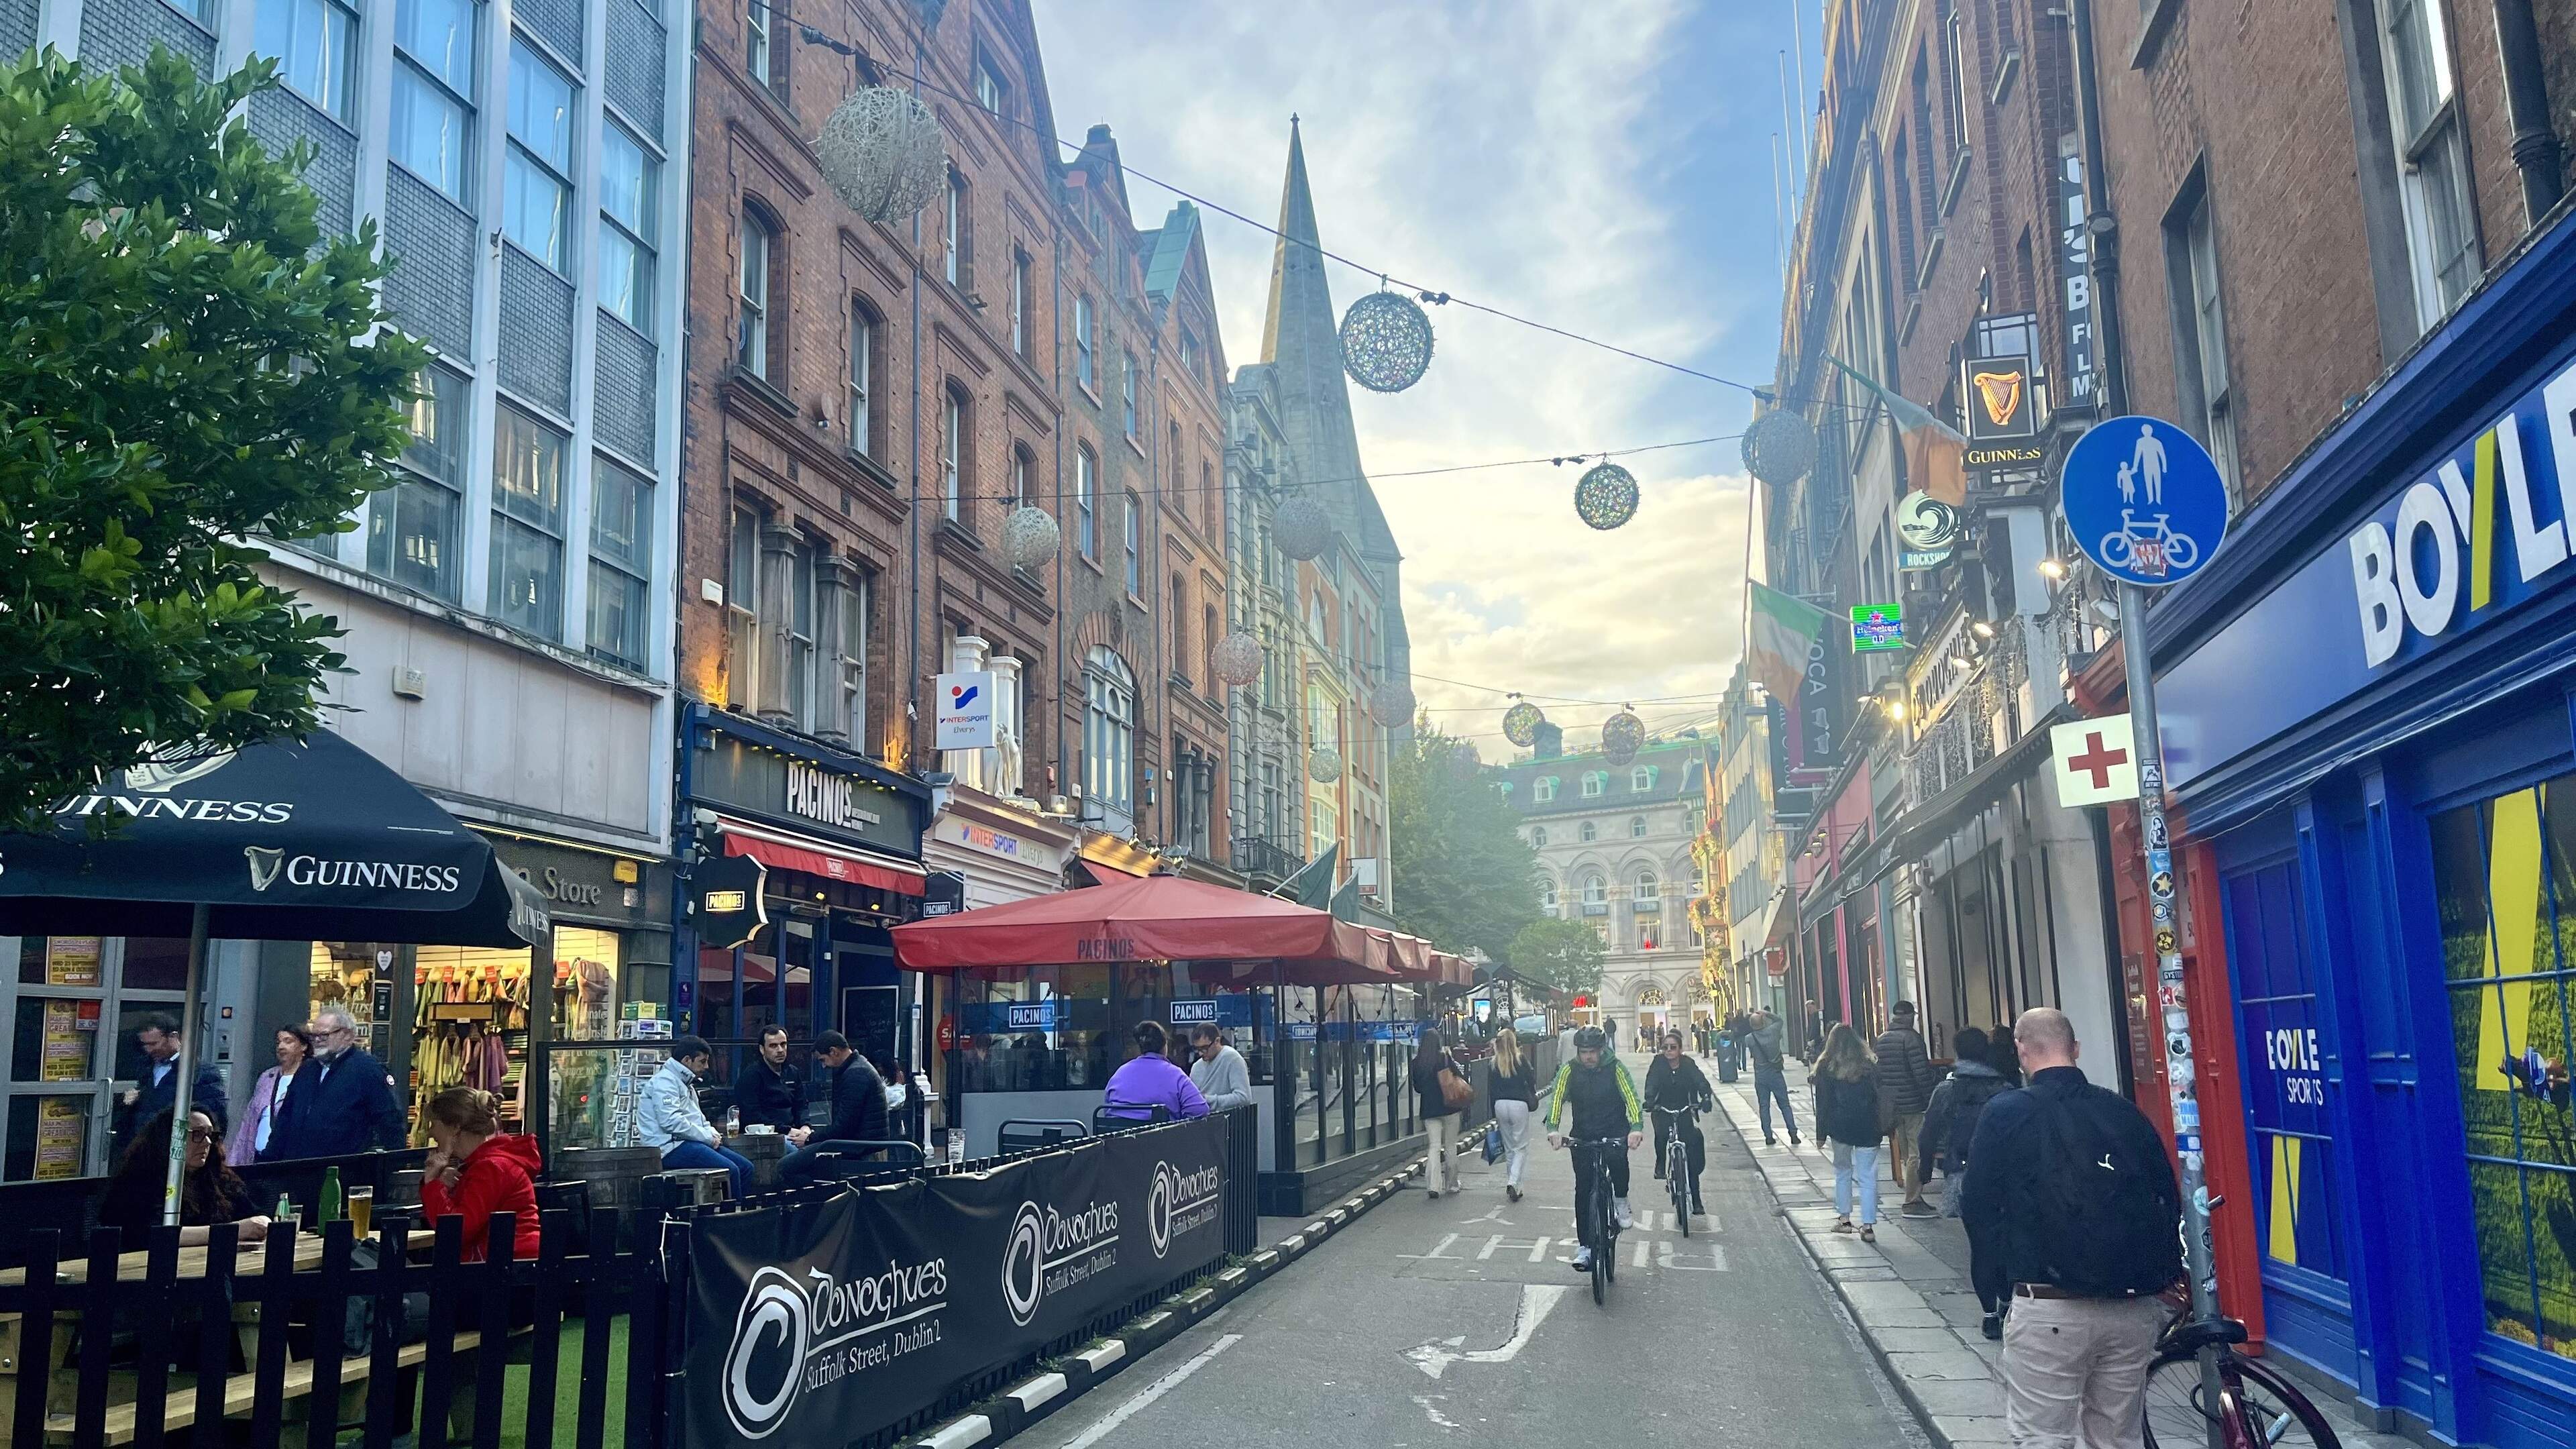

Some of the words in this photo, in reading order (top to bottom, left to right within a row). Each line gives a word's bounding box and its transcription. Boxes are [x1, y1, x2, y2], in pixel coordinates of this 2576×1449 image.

[1808, 637, 1827, 696] OCA
[947, 715, 989, 723] INTERSPORT
[787, 761, 853, 826] PACINOS
[46, 795, 294, 824] UINNESS
[970, 826, 1018, 855] INTERSPORT
[287, 855, 460, 892] GUINNESS
[544, 867, 602, 905] Store
[709, 894, 742, 908] PACINOS
[925, 905, 949, 915] PACINOS
[1078, 939, 1134, 959] PACINOS
[1013, 1009, 1051, 1024] PACINOS
[1175, 1004, 1214, 1020] PACINOS
[2287, 1077, 2323, 1106] SPORTS
[1046, 1267, 1069, 1296] Suffolk
[1091, 1250, 1112, 1275] Dublin
[1112, 1248, 1116, 1266] 2
[806, 1350, 846, 1393] Suffolk
[849, 1340, 890, 1373] Street,
[894, 1322, 934, 1357] Dublin
[933, 1319, 941, 1342] 2
